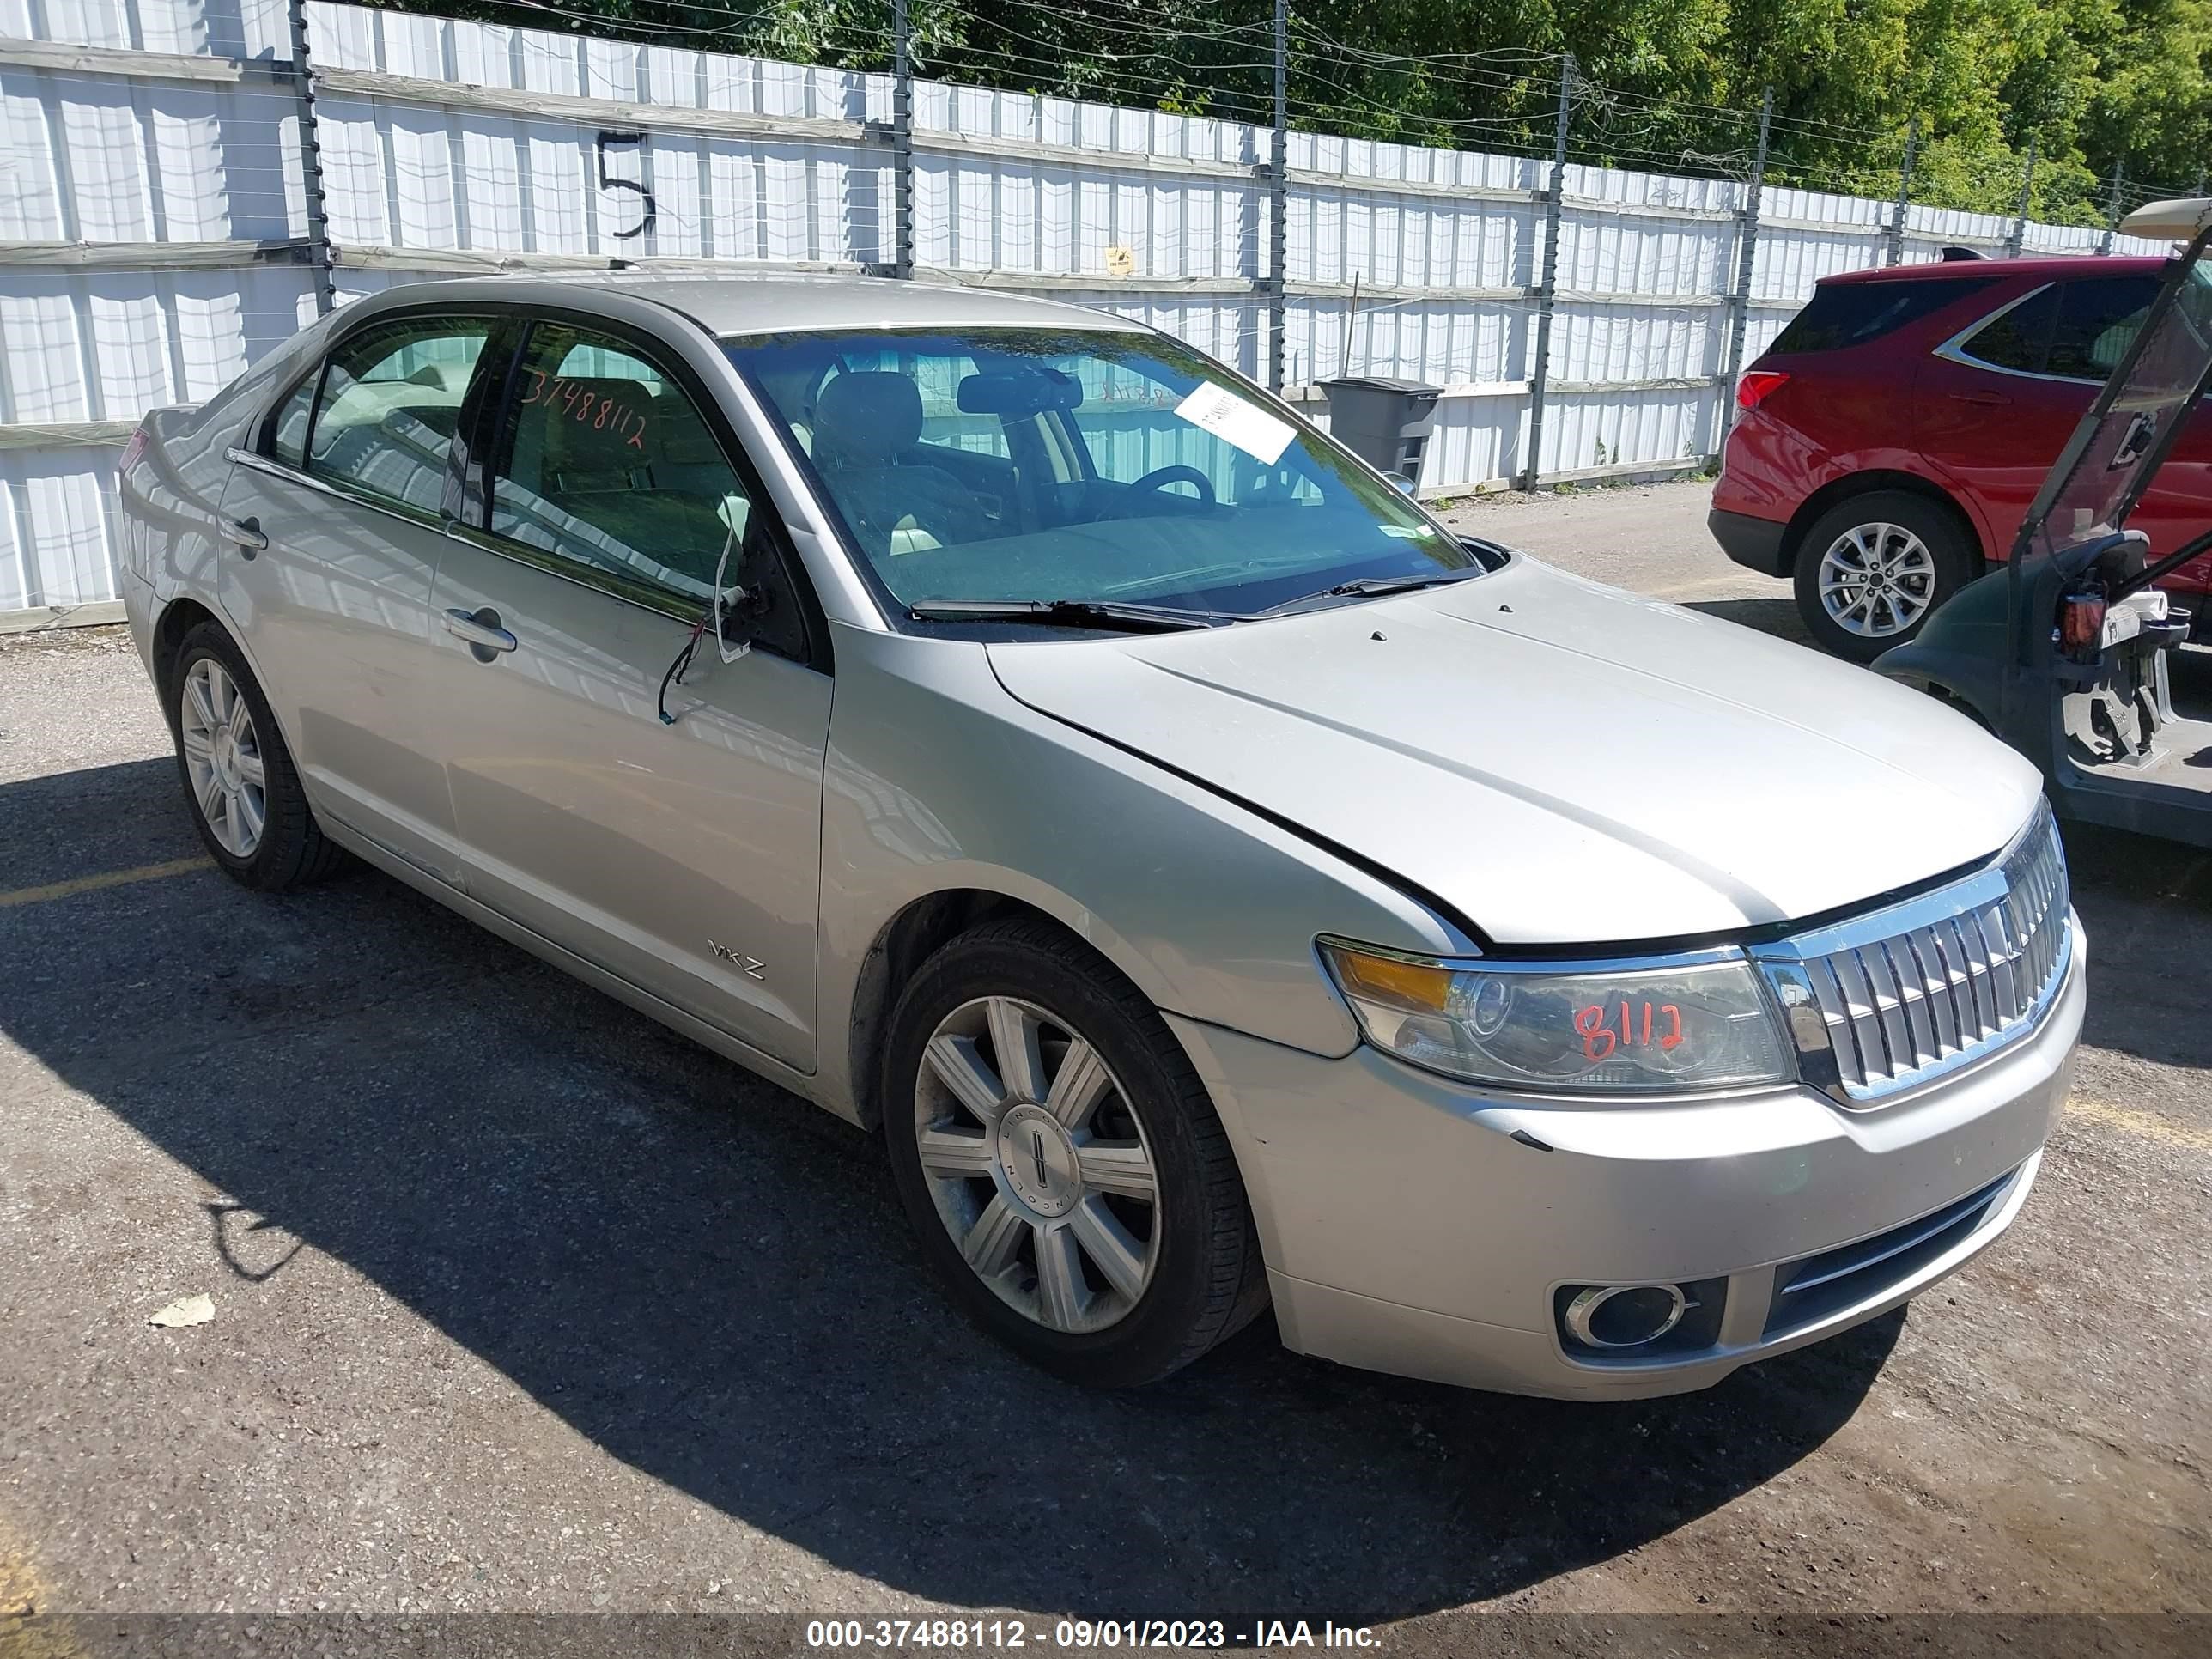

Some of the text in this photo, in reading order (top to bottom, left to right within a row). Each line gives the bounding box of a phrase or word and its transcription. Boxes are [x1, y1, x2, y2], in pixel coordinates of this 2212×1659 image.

[597, 131, 657, 238] 5
[521, 370, 646, 449] 37488112
[707, 939, 767, 981] MKZ
[1575, 1001, 1685, 1062] 8112
